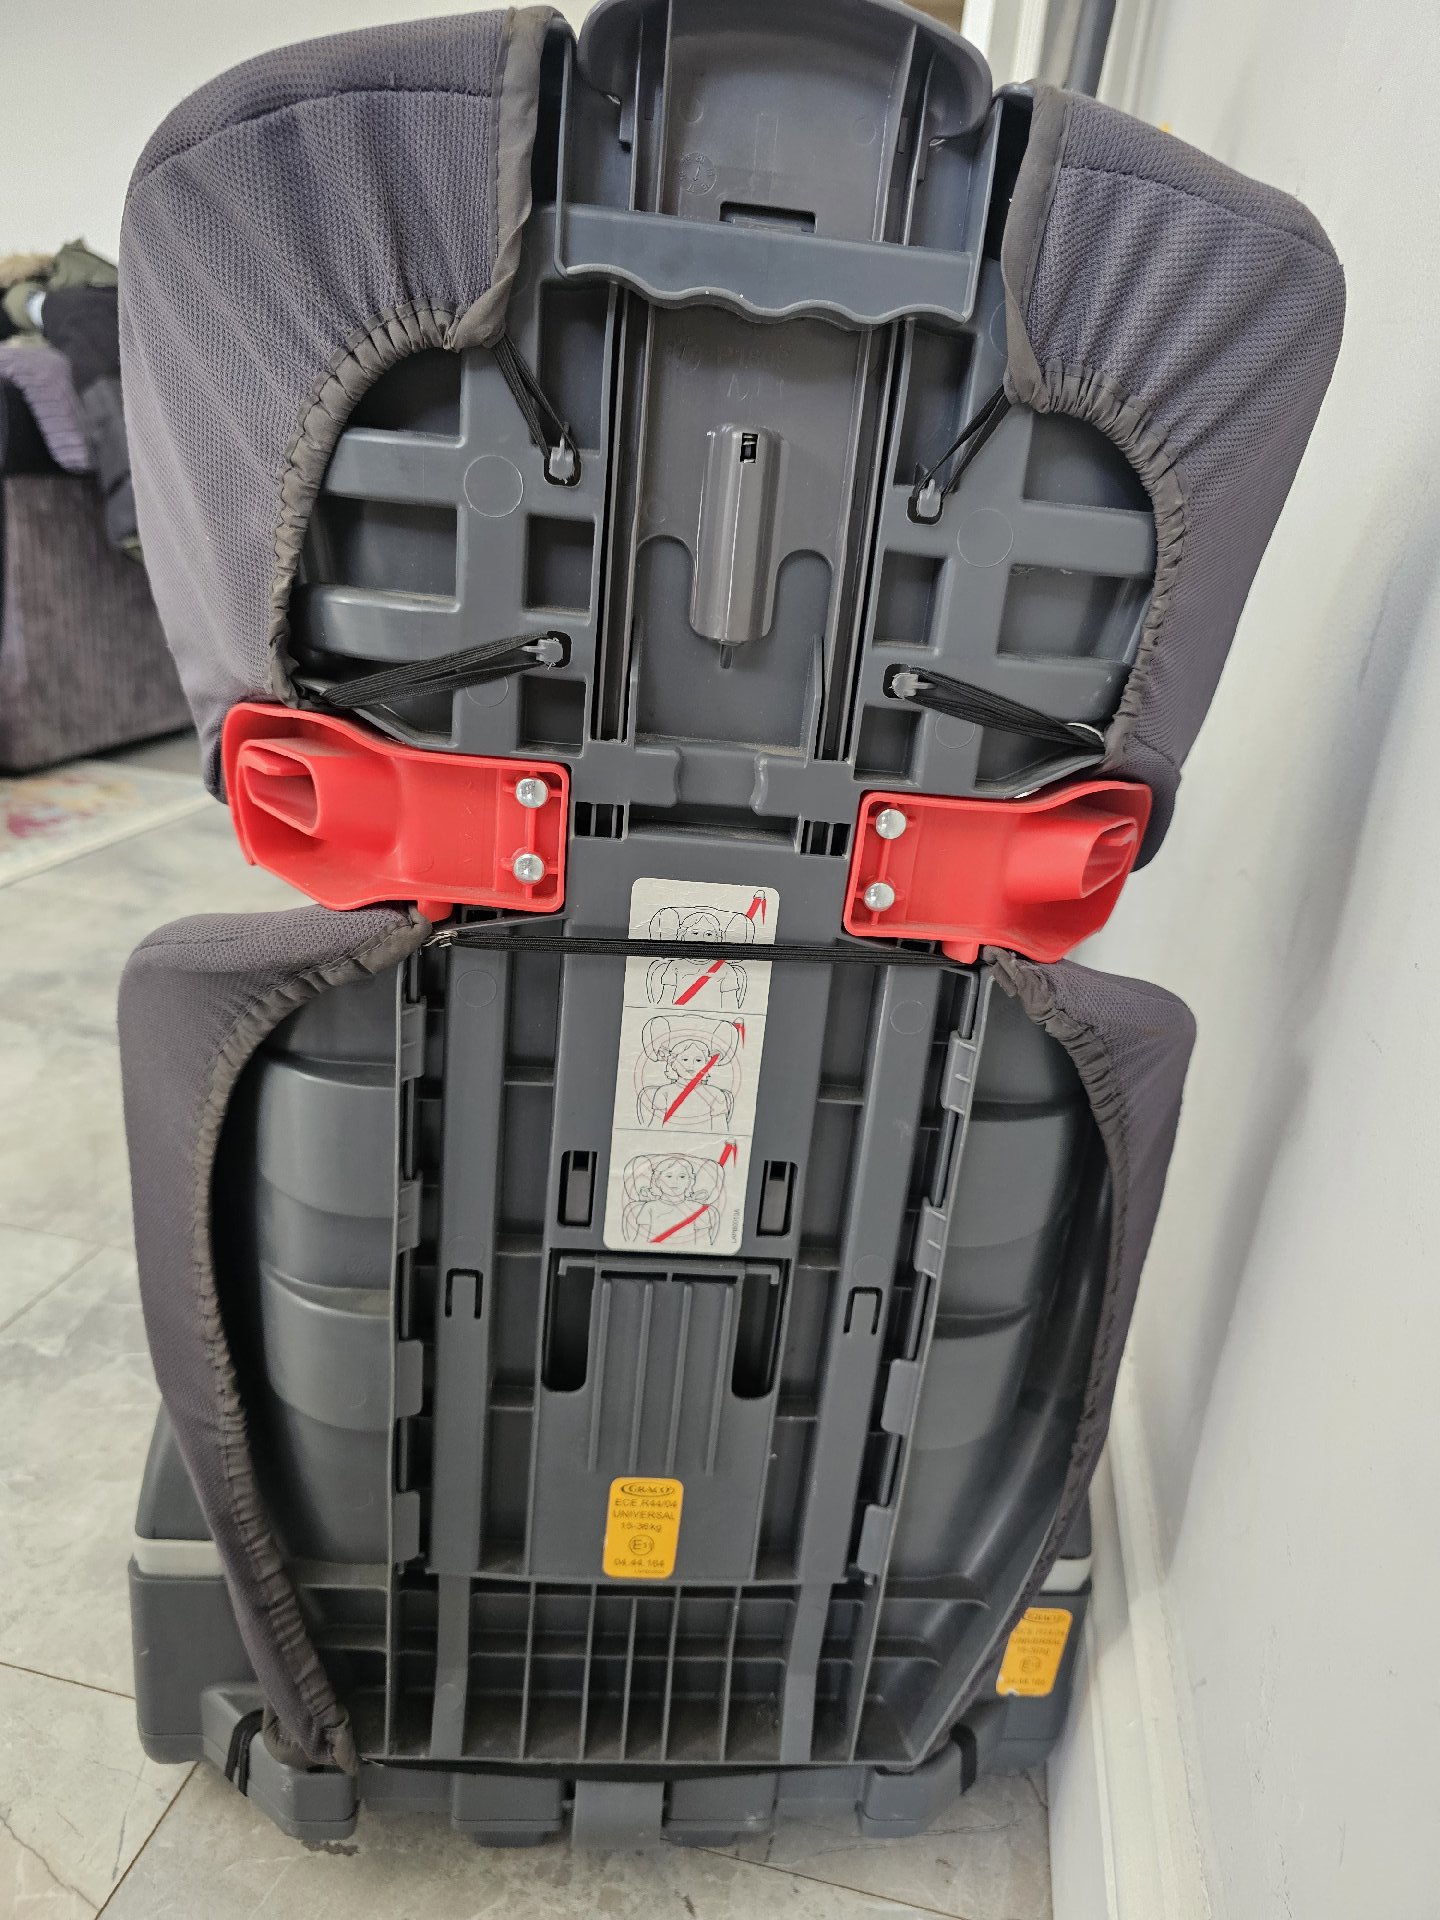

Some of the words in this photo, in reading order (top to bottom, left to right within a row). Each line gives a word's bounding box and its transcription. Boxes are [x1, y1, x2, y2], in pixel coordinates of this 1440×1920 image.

[628, 1484, 670, 1493] GRACO
[615, 1498, 637, 1507] ECE
[641, 1499, 678, 1508] R44/04
[613, 1509, 675, 1520] UNIVERSAL
